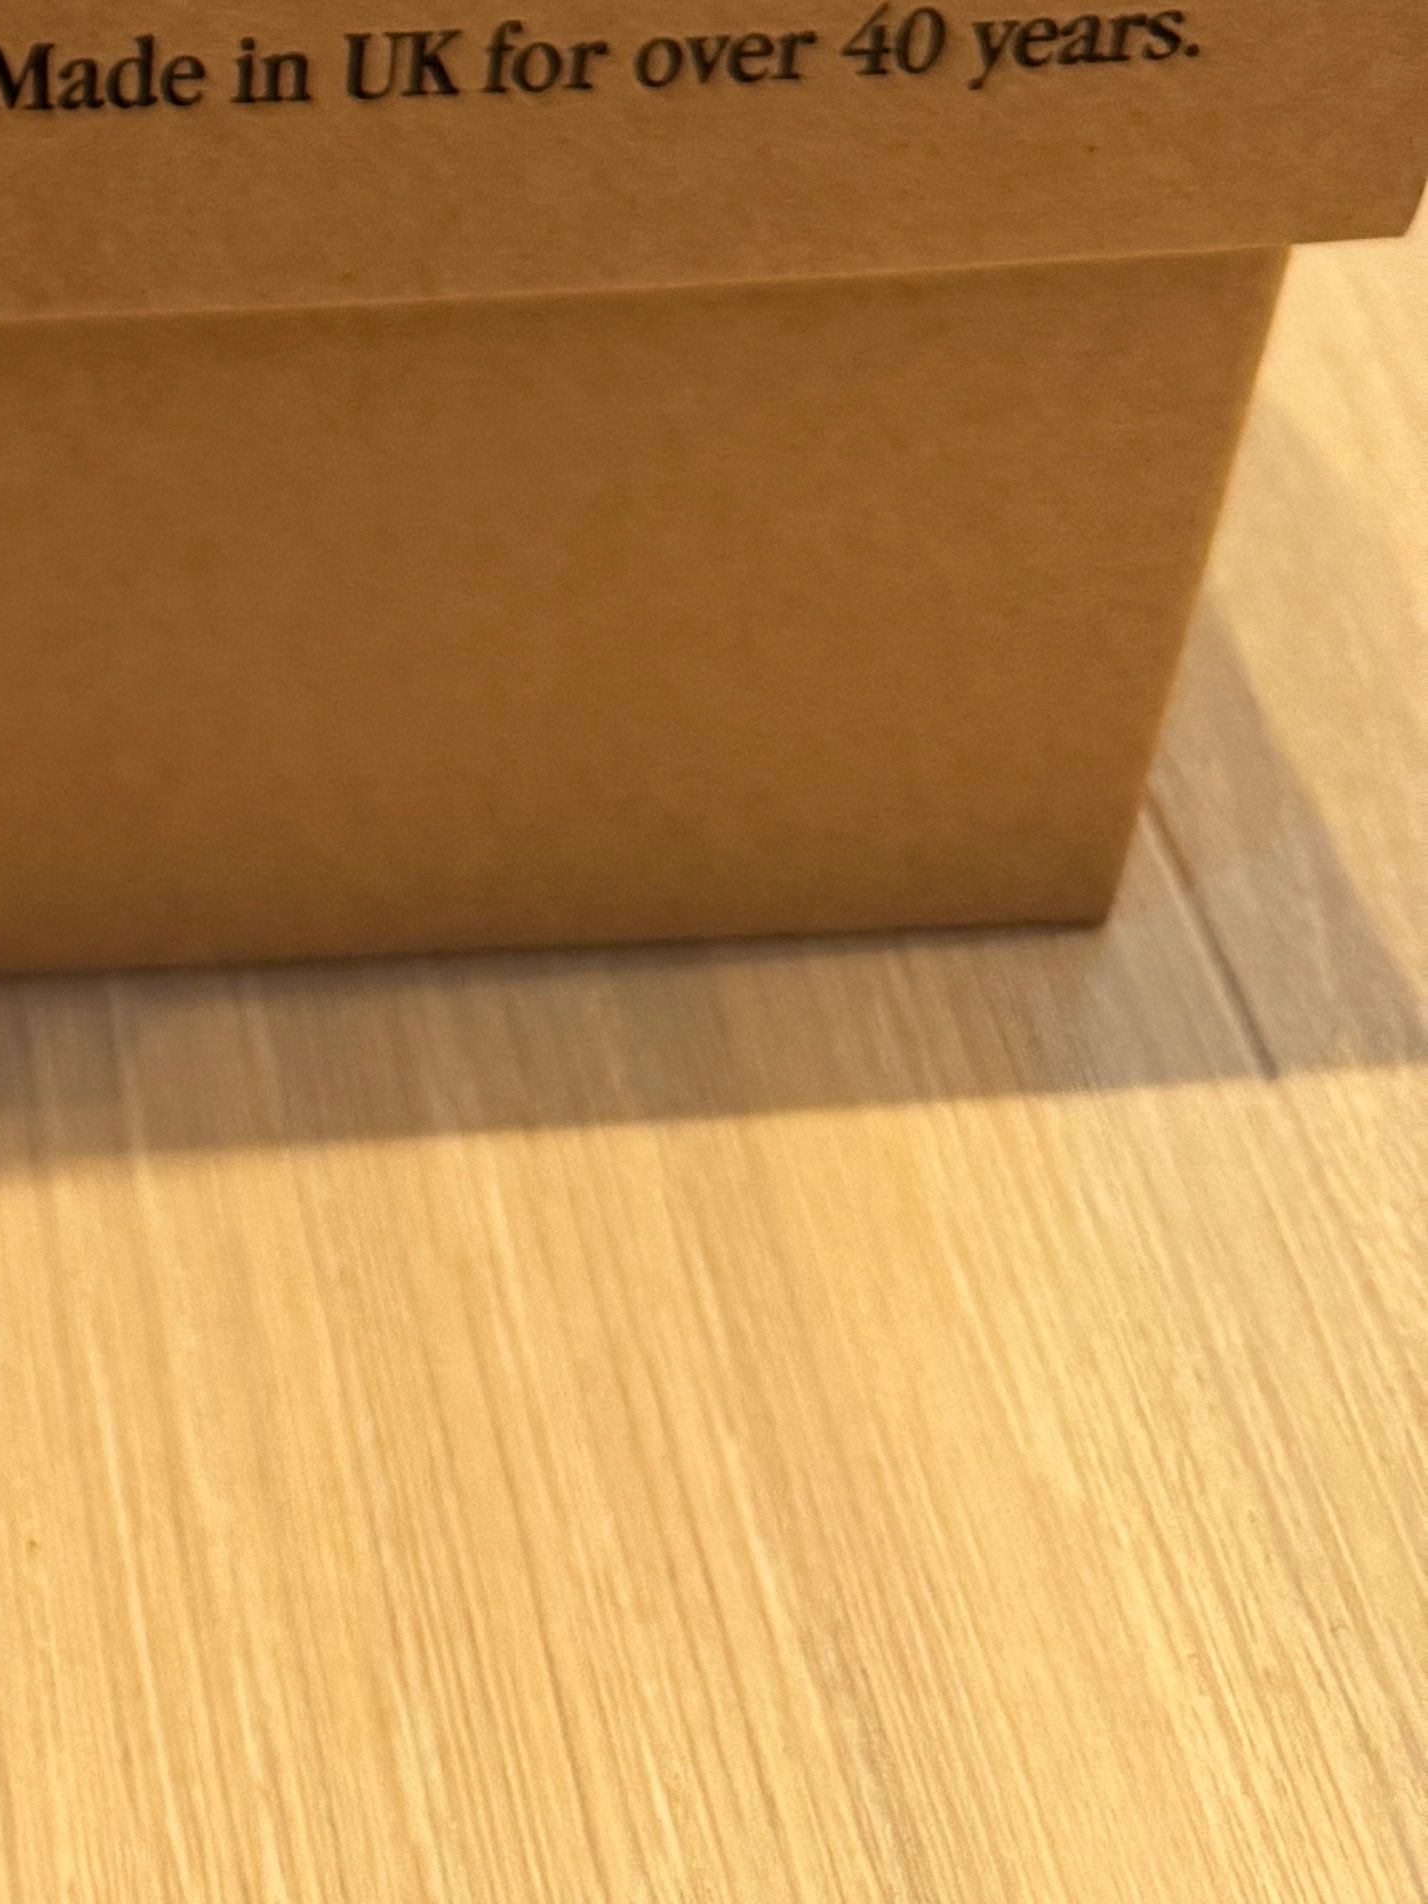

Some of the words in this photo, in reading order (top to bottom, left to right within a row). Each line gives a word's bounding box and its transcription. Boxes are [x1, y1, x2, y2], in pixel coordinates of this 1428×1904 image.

[229, 36, 315, 109] in
[343, 29, 464, 105] UK
[480, 20, 612, 96] for
[633, 30, 820, 91] over
[839, 2, 951, 78] 40
[966, 9, 1202, 91] years.
